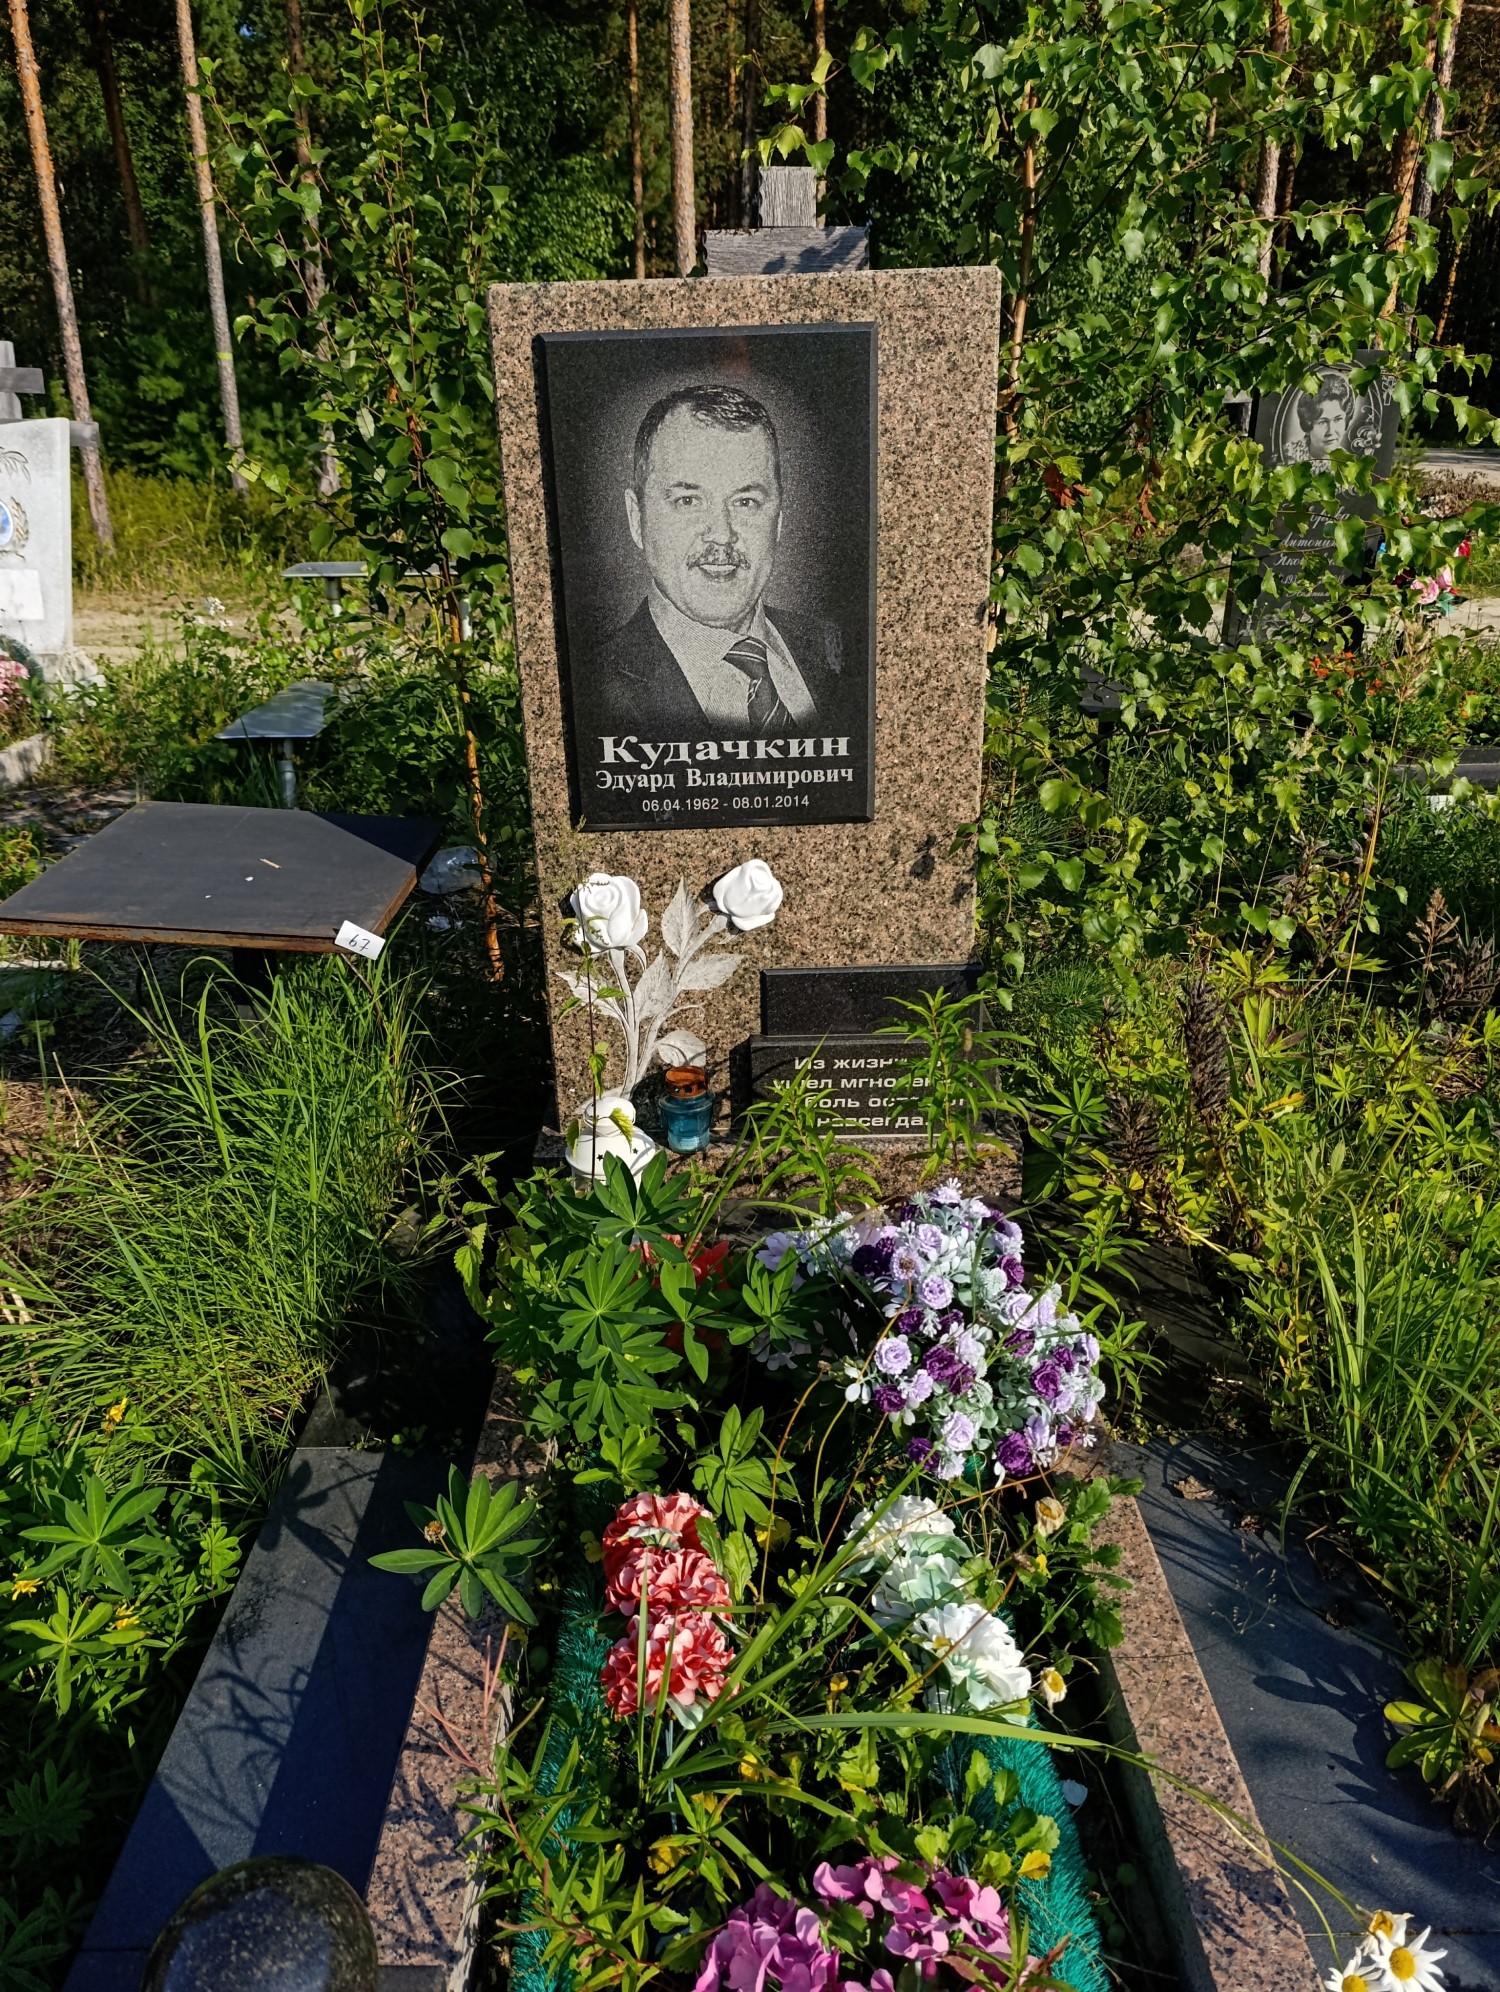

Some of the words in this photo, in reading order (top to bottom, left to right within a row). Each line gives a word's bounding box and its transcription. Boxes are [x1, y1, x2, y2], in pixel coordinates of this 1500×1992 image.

[598, 735, 850, 770] Кудачкин
[595, 769, 675, 793] Эдуард
[686, 767, 854, 789] Владимирович
[642, 797, 719, 812] 06.04.1962
[732, 795, 810, 809] 08.01.2014
[348, 934, 371, 952] 67
[832, 1058, 909, 1069] жизн
